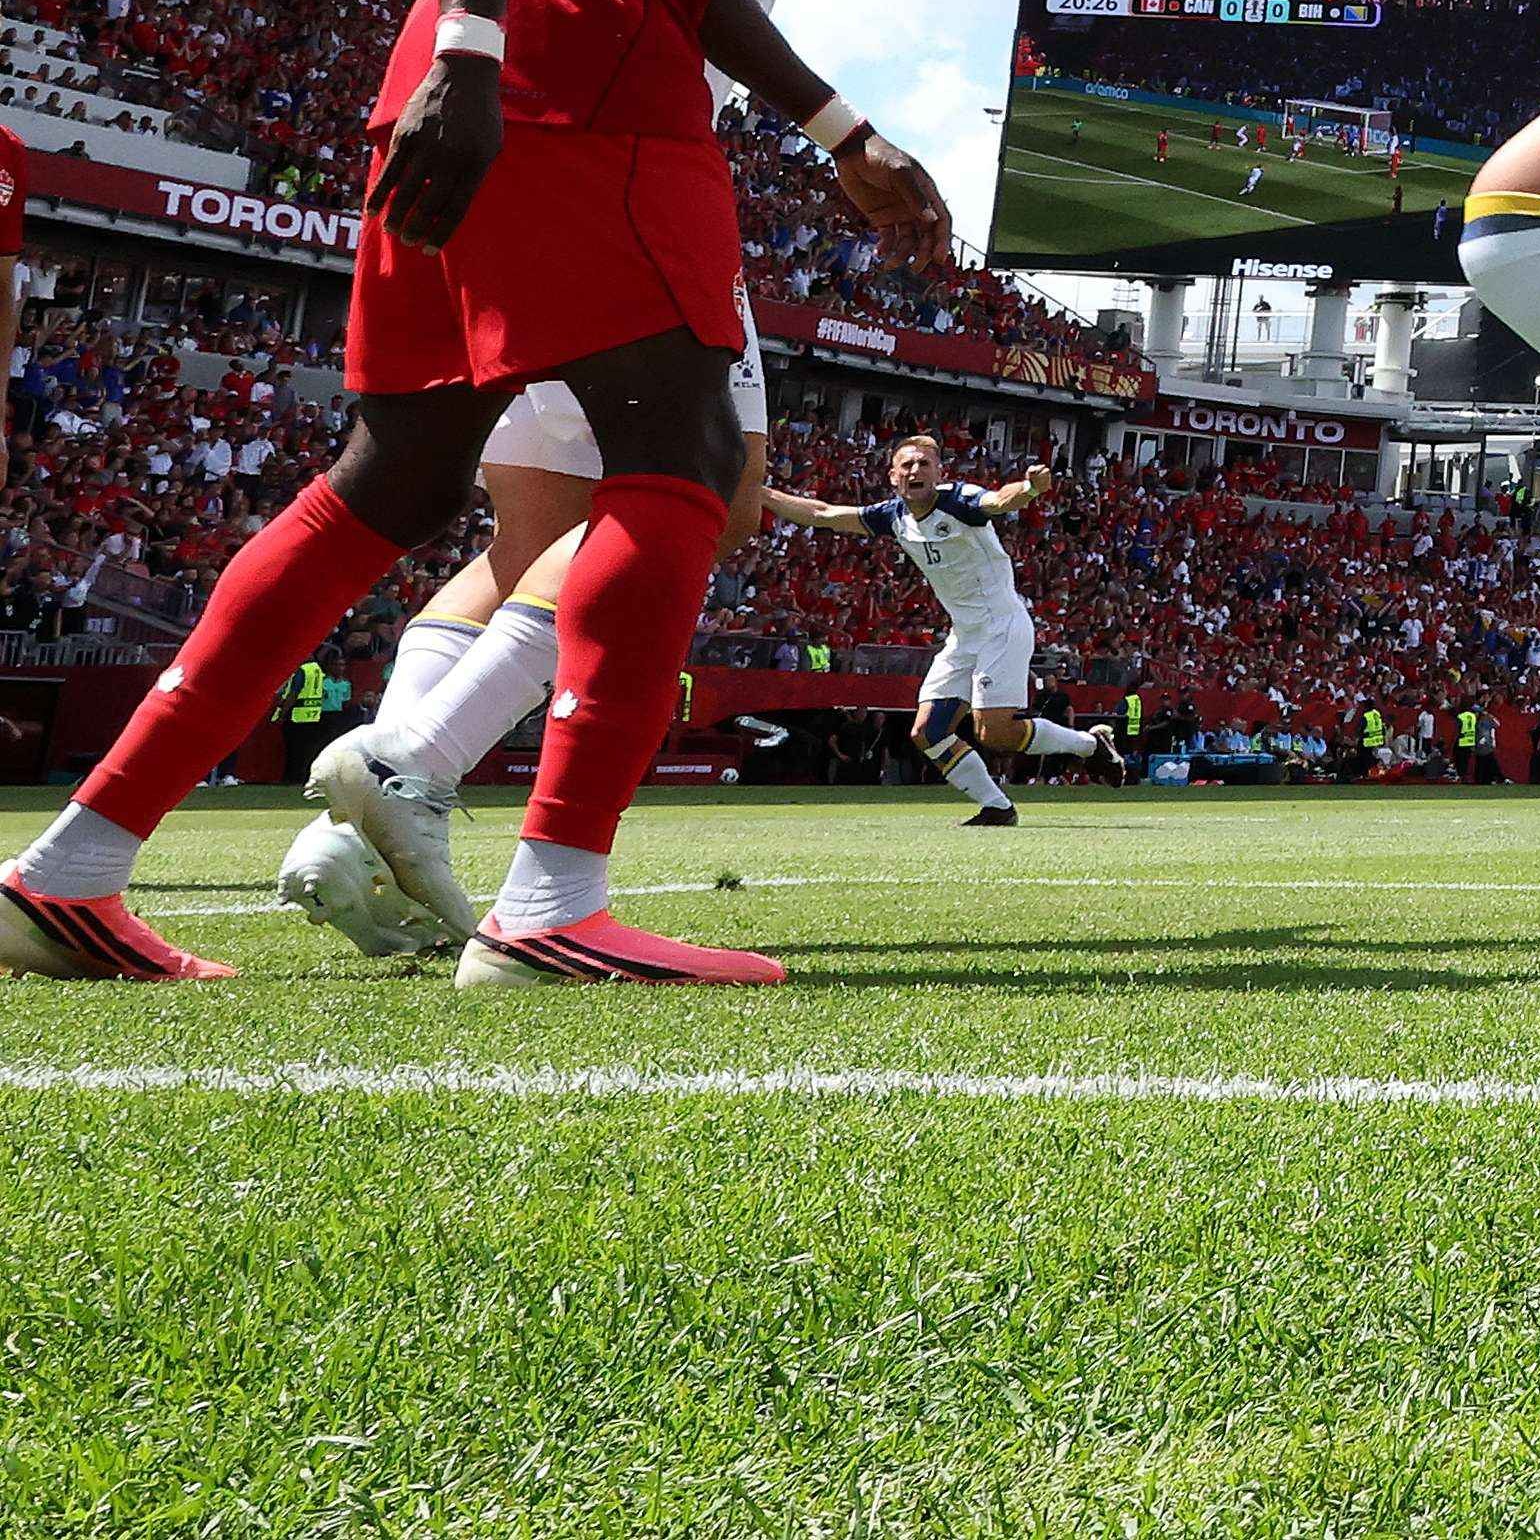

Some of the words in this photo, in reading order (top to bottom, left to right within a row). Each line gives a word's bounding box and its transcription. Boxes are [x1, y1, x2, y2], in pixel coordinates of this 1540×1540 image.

[1225, 2, 1240, 17] 0
[1271, 3, 1285, 19] 0
[1298, 3, 1324, 20] BIH
[157, 180, 363, 250] TORONT
[1231, 258, 1334, 279] Hisense
[1168, 403, 1345, 444] TORONTO
[923, 541, 942, 564] 15
